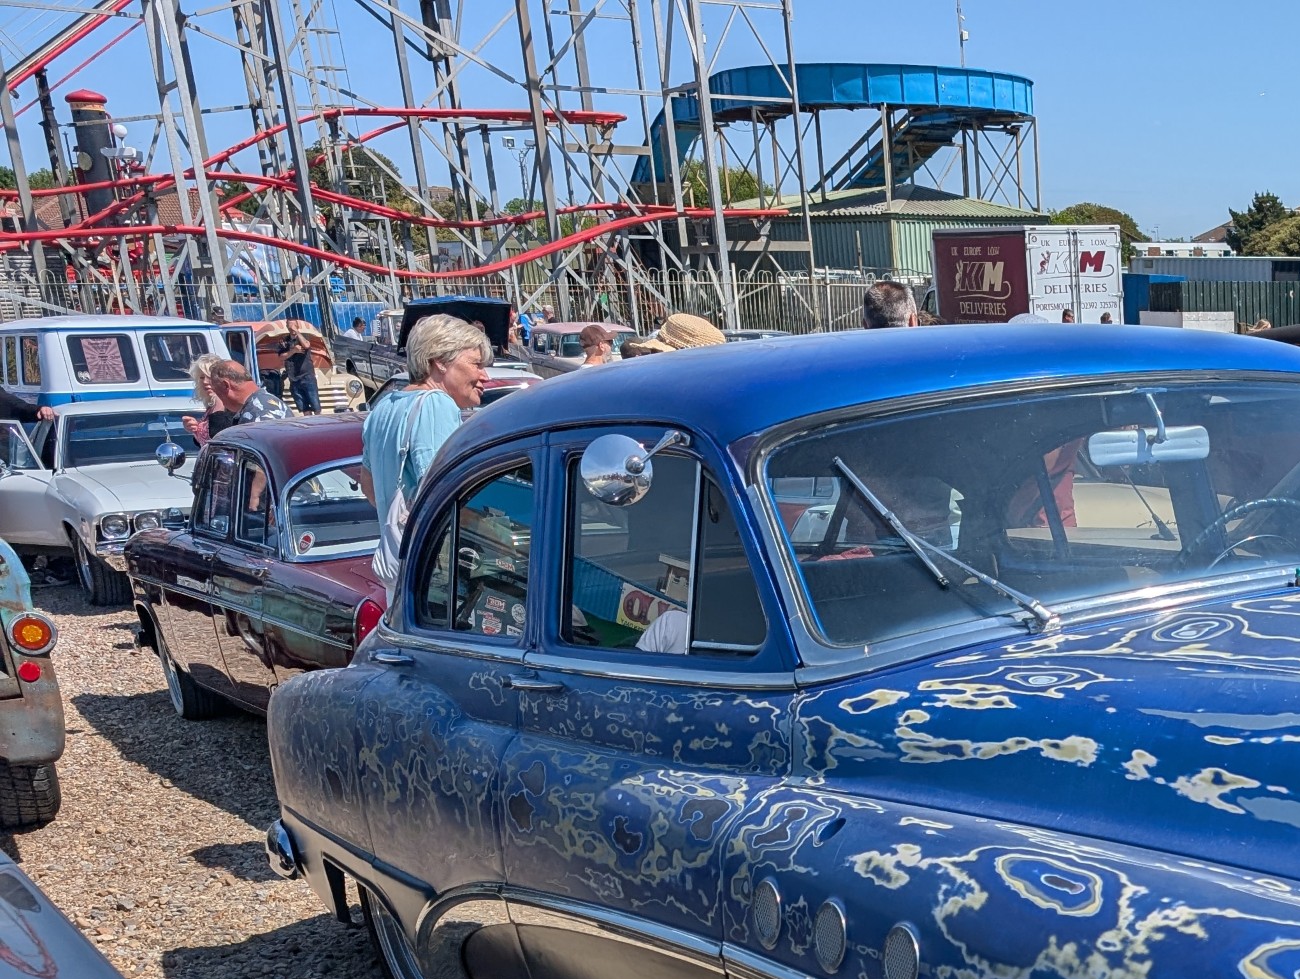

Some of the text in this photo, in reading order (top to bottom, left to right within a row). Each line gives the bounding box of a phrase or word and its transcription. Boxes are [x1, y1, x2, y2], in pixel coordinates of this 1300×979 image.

[1040, 239, 1051, 247] UK
[1058, 239, 1085, 247] EUOE
[951, 246, 958, 256] UK
[963, 246, 982, 256] EUROPE
[959, 301, 1007, 316] DELIVERIES
[1035, 302, 1074, 311] PORTSMOUT
